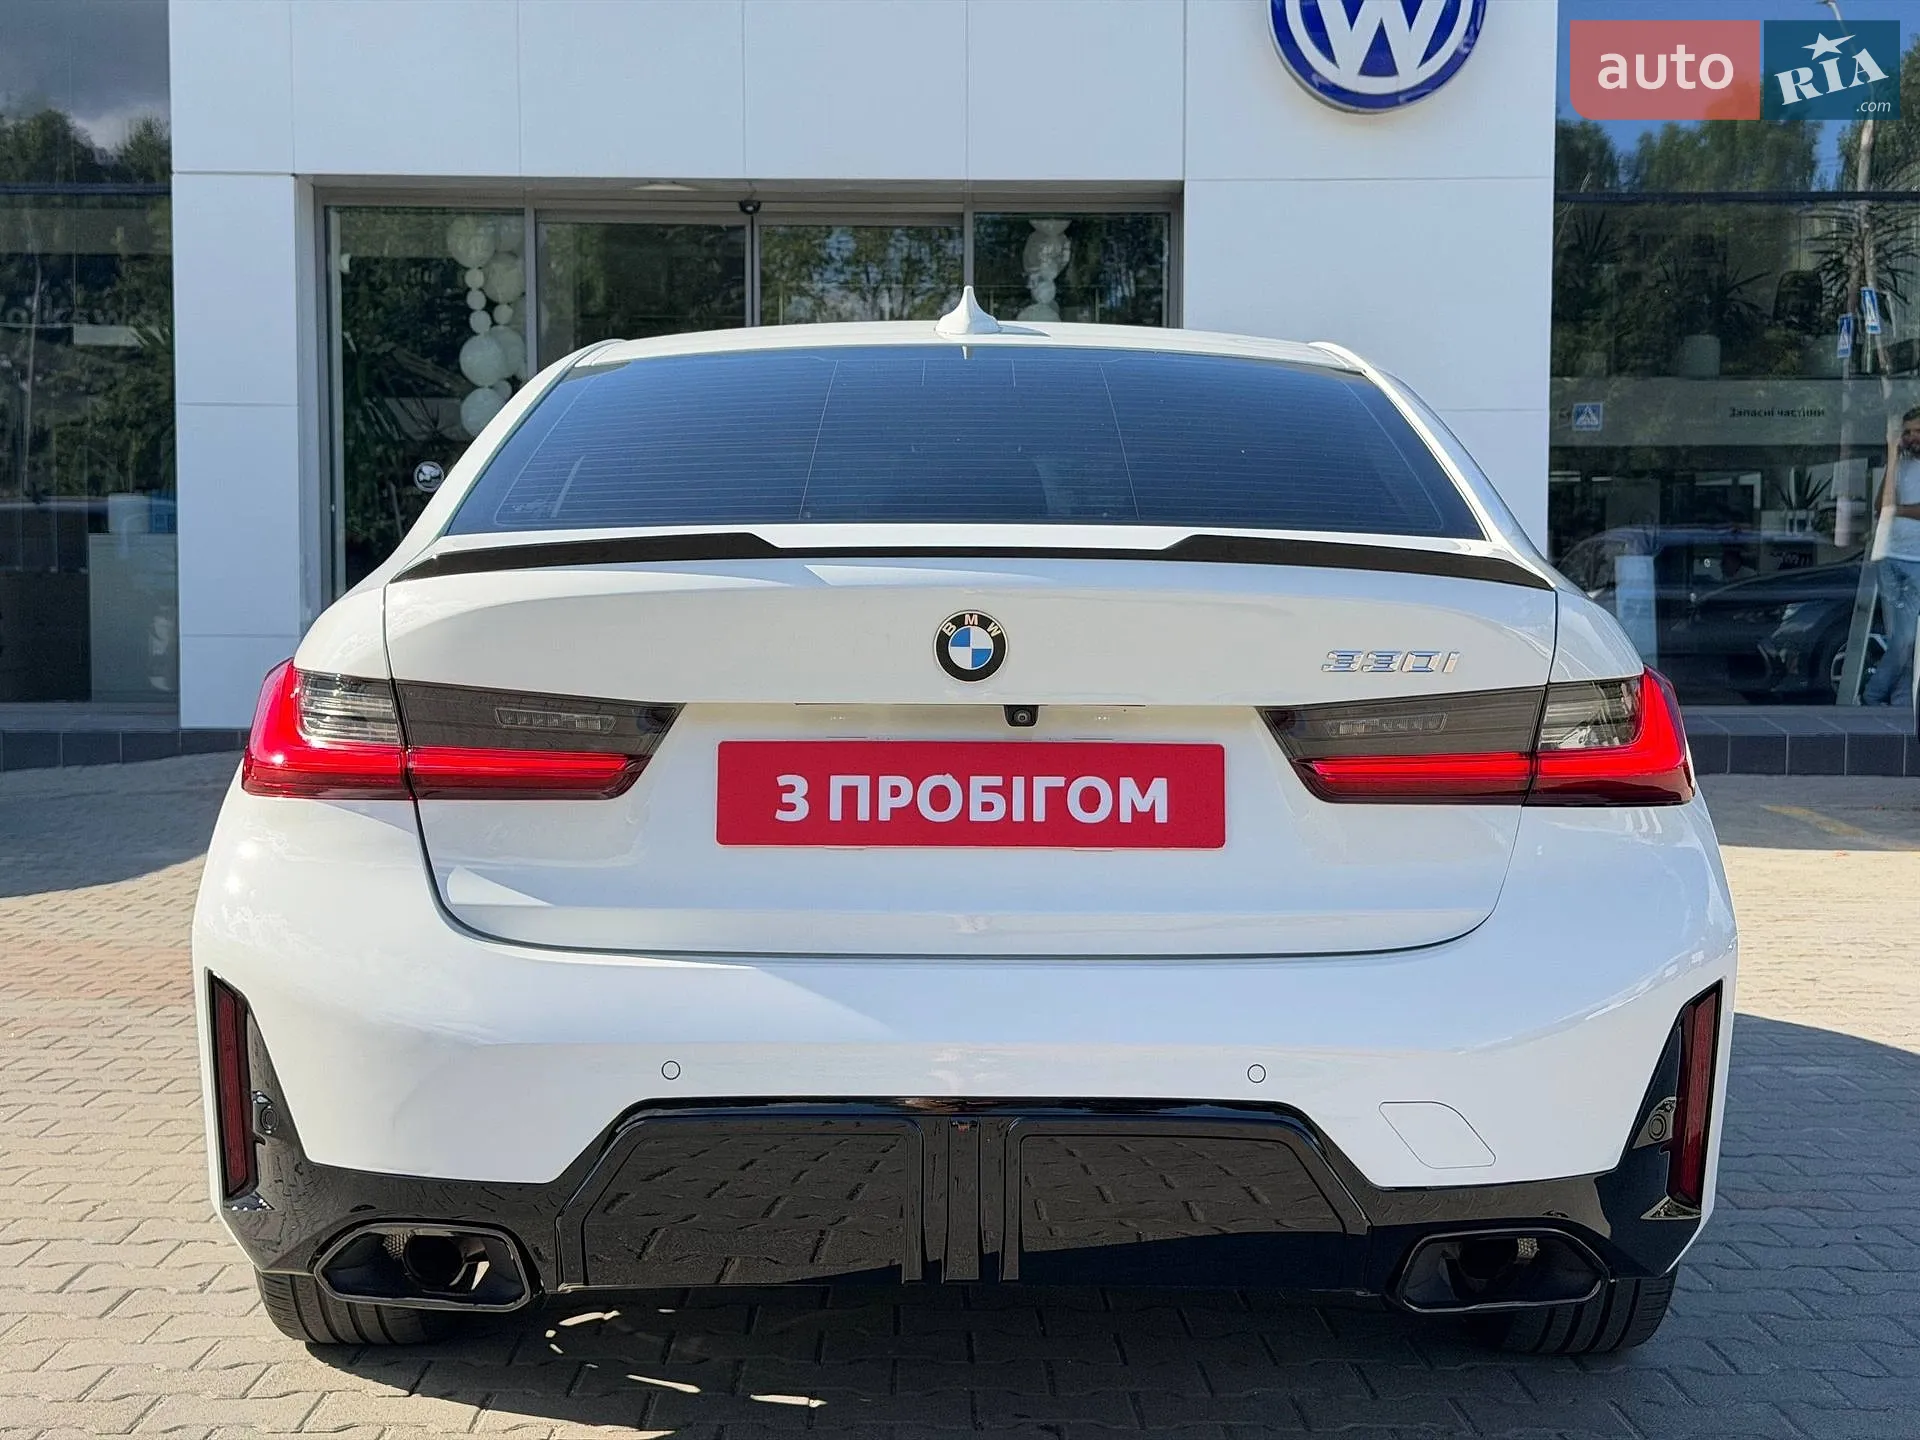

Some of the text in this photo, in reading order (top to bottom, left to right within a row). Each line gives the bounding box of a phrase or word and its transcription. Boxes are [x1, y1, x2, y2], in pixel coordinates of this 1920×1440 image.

[1729, 406, 1774, 418] Запасні
[941, 613, 1002, 638] BMW
[774, 773, 1170, 824] З ПРОБІГОМ
